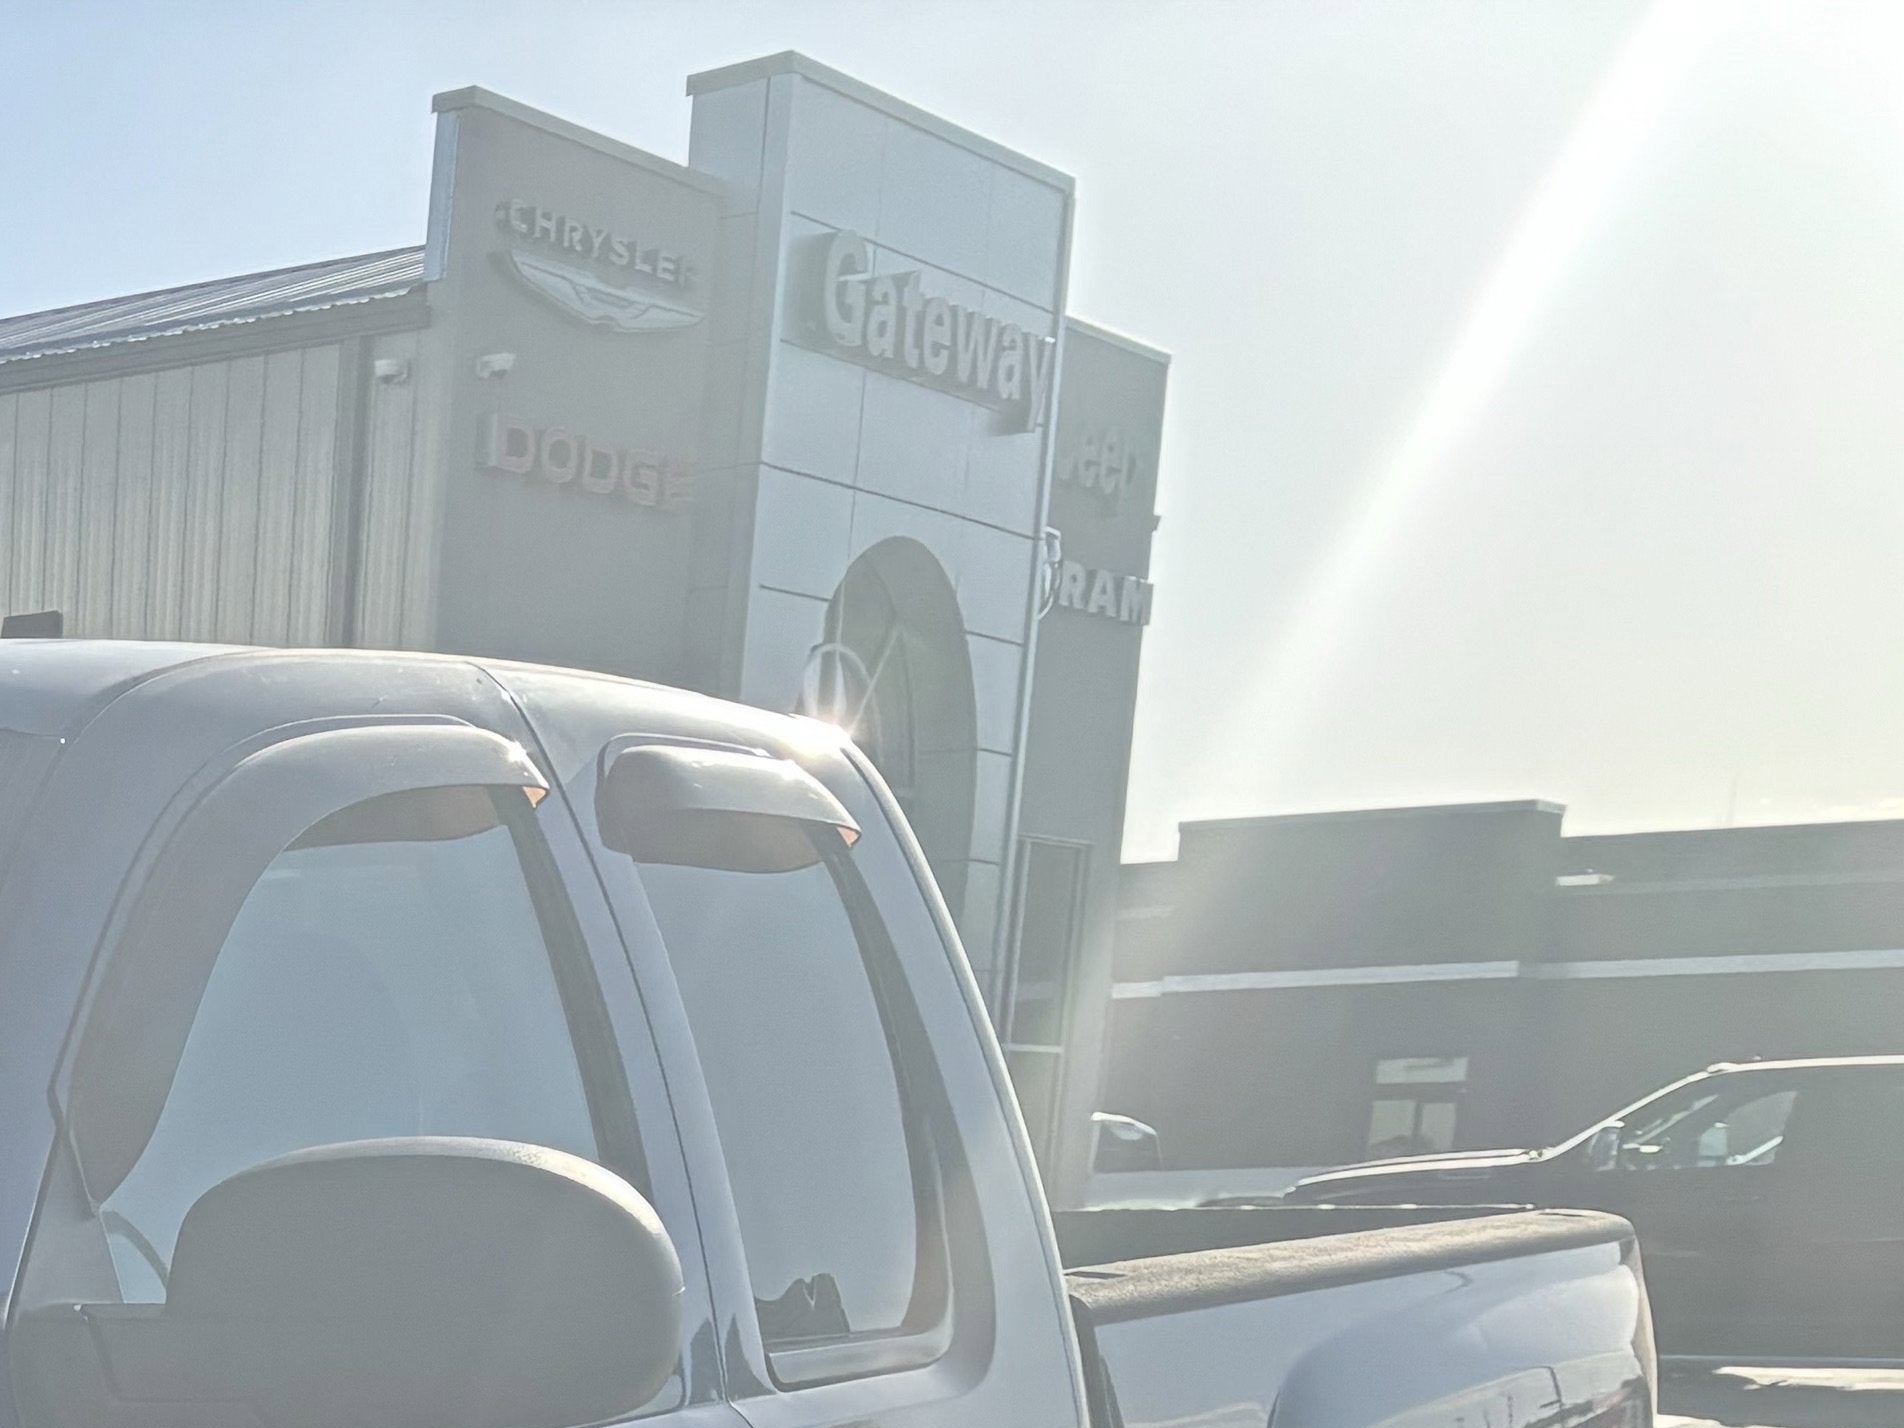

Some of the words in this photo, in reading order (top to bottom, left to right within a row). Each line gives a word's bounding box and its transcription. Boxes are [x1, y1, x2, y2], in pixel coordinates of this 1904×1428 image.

[824, 229, 1054, 434] Gateway
[488, 412, 695, 511] DODGE
[1059, 560, 1151, 625] RAM
